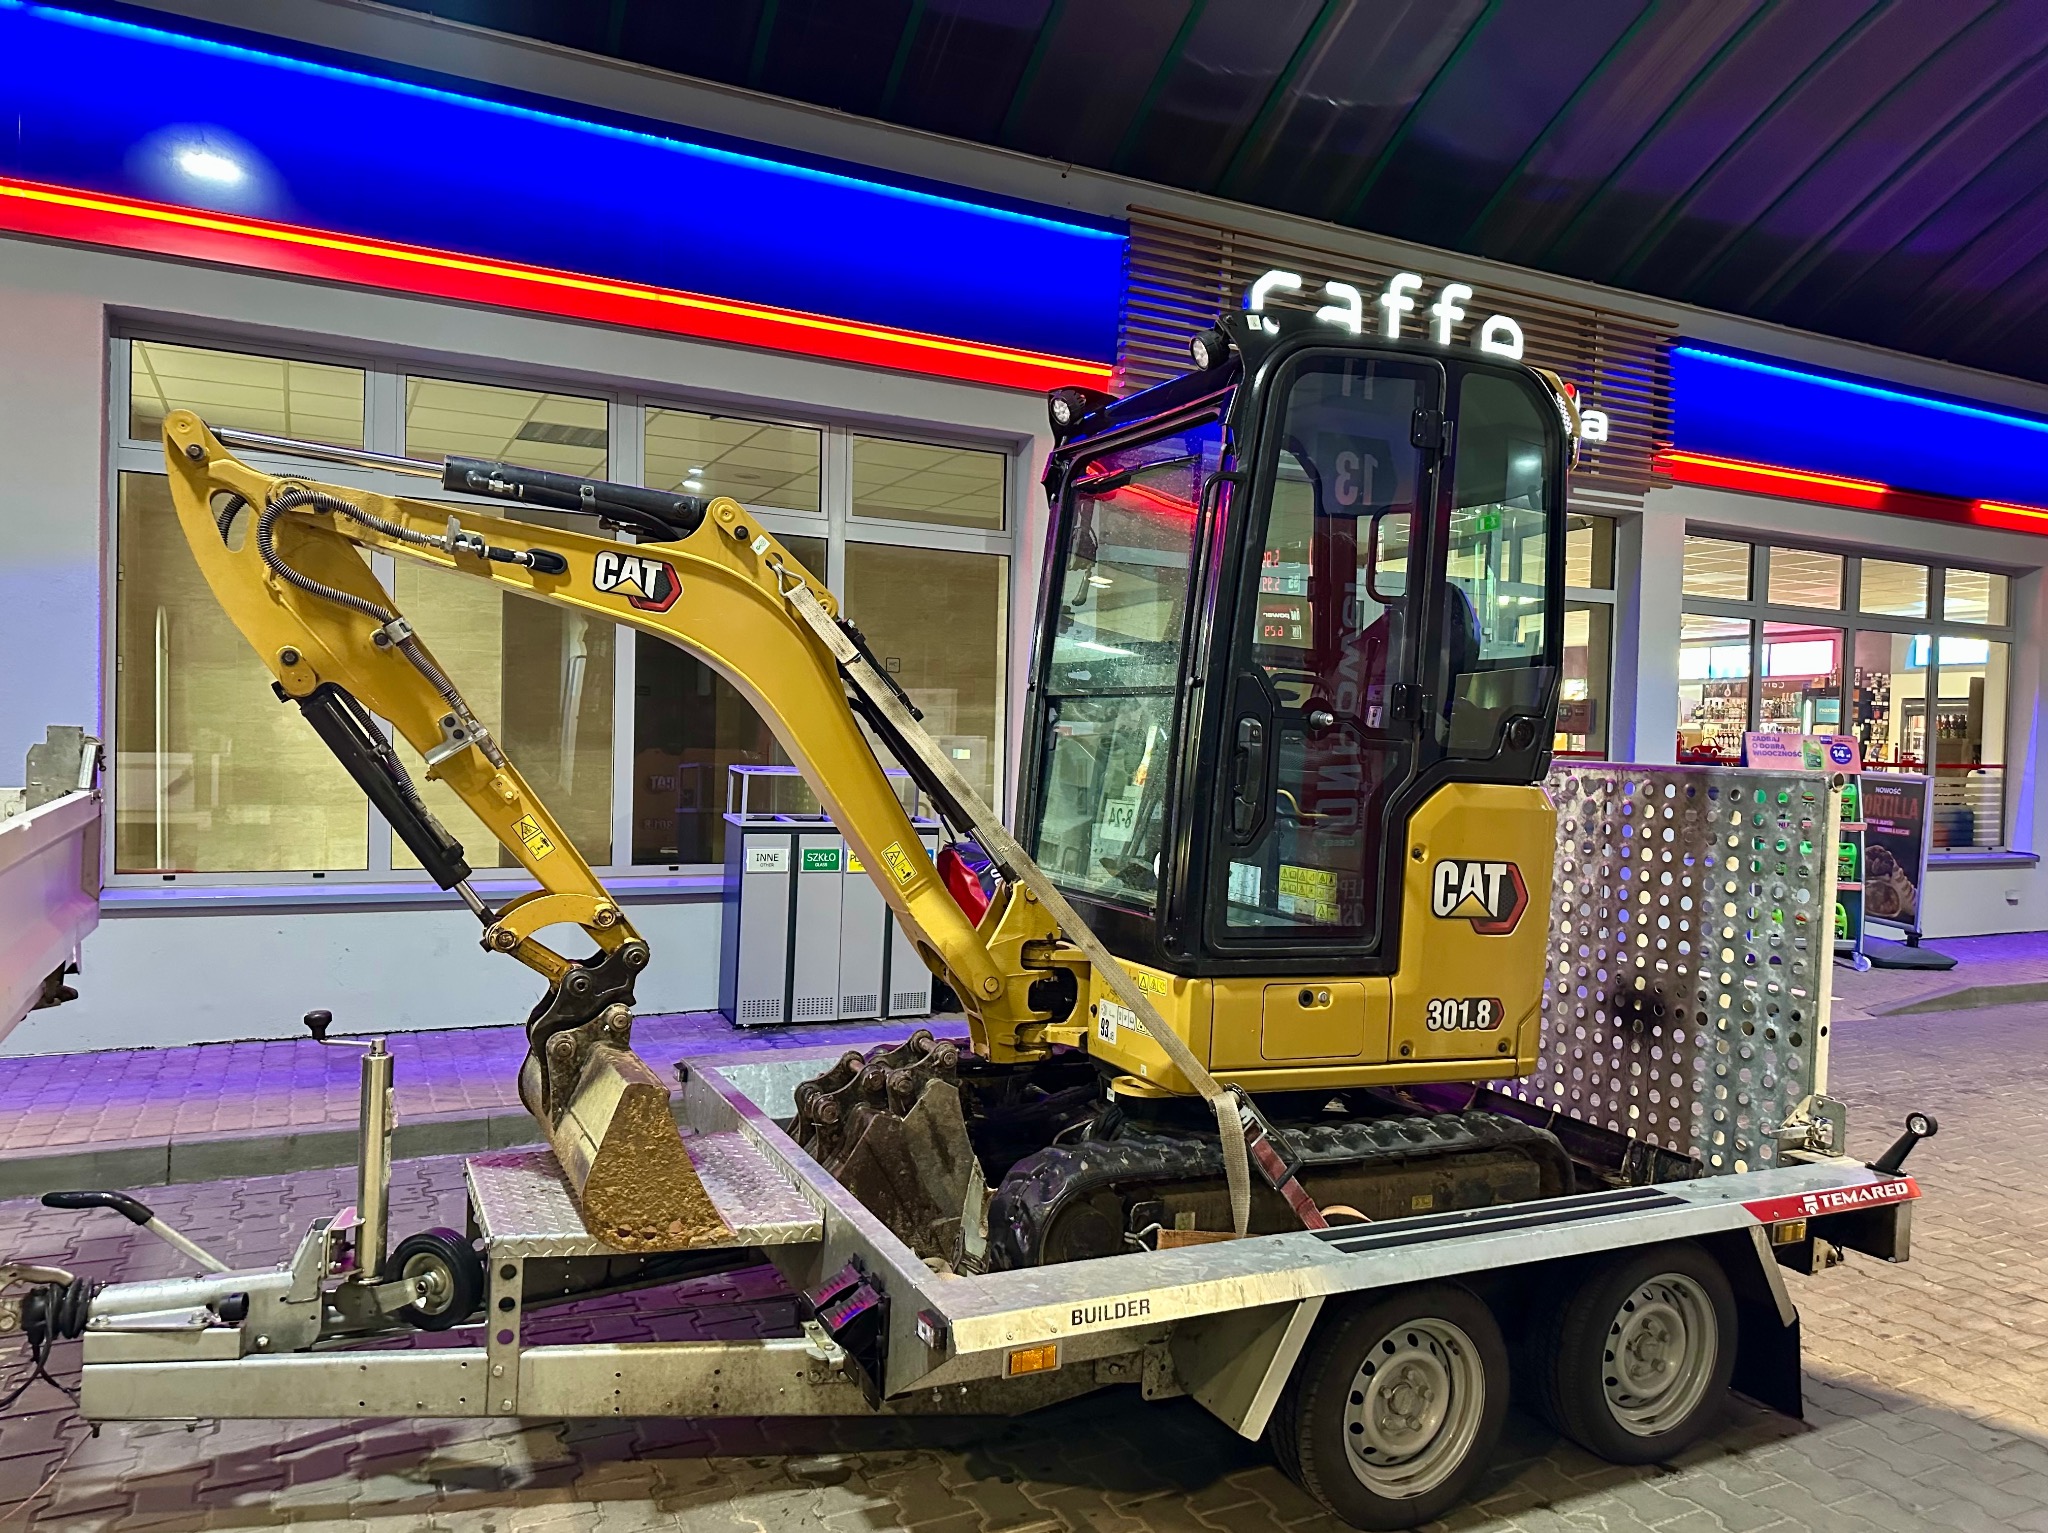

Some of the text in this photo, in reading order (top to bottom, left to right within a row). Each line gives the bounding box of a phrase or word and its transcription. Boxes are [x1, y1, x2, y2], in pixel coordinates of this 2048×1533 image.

[595, 552, 663, 599] CAT
[1833, 750, 1845, 758] 14
[1863, 793, 1918, 819] ORTILLA
[756, 853, 779, 862] INNE
[806, 853, 837, 862] SZKŁO
[1434, 861, 1507, 917] CAT
[1100, 1017, 1110, 1037] 93
[1427, 999, 1491, 1030] 301.8
[1819, 1182, 1909, 1208] TEMARED
[1071, 1299, 1151, 1326] BUILDER
